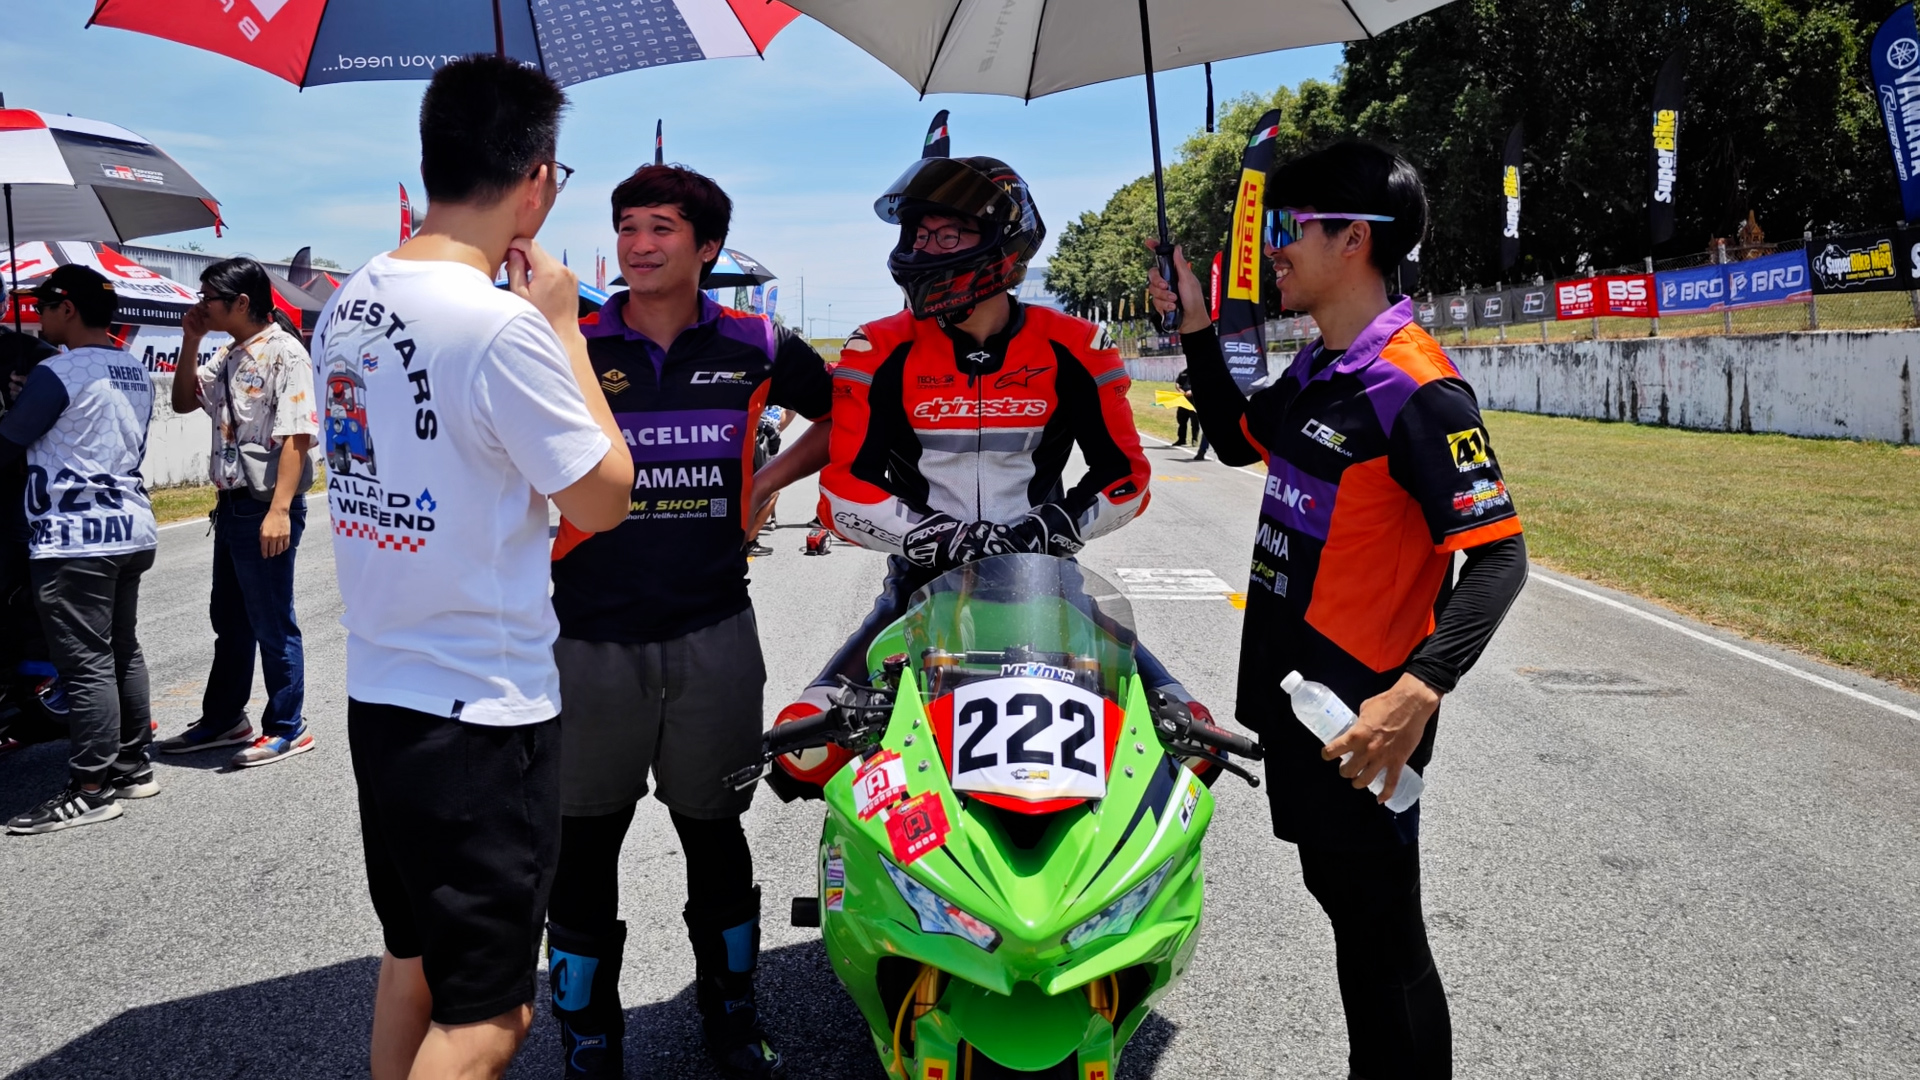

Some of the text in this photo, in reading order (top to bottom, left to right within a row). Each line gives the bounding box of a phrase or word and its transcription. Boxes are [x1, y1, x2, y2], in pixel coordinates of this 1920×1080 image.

[1237, 181, 1258, 291] PIRELLI
[1607, 279, 1647, 301] BS
[1751, 265, 1804, 293] BRD
[1559, 283, 1594, 305] BS
[123, 307, 182, 319] RACE EXPERIENCE
[107, 364, 144, 382] ENERGY
[120, 382, 131, 391] THE
[914, 396, 1048, 422] alpinestars
[25, 464, 125, 517] 023
[635, 465, 724, 490] AMAHA
[329, 477, 411, 509] AILAD
[655, 499, 709, 511] SHOP
[337, 496, 436, 532] WEEEND
[82, 515, 134, 545] DAY
[834, 511, 901, 547] alpines
[1255, 522, 1290, 561] MAHA
[958, 693, 1098, 778] 222
